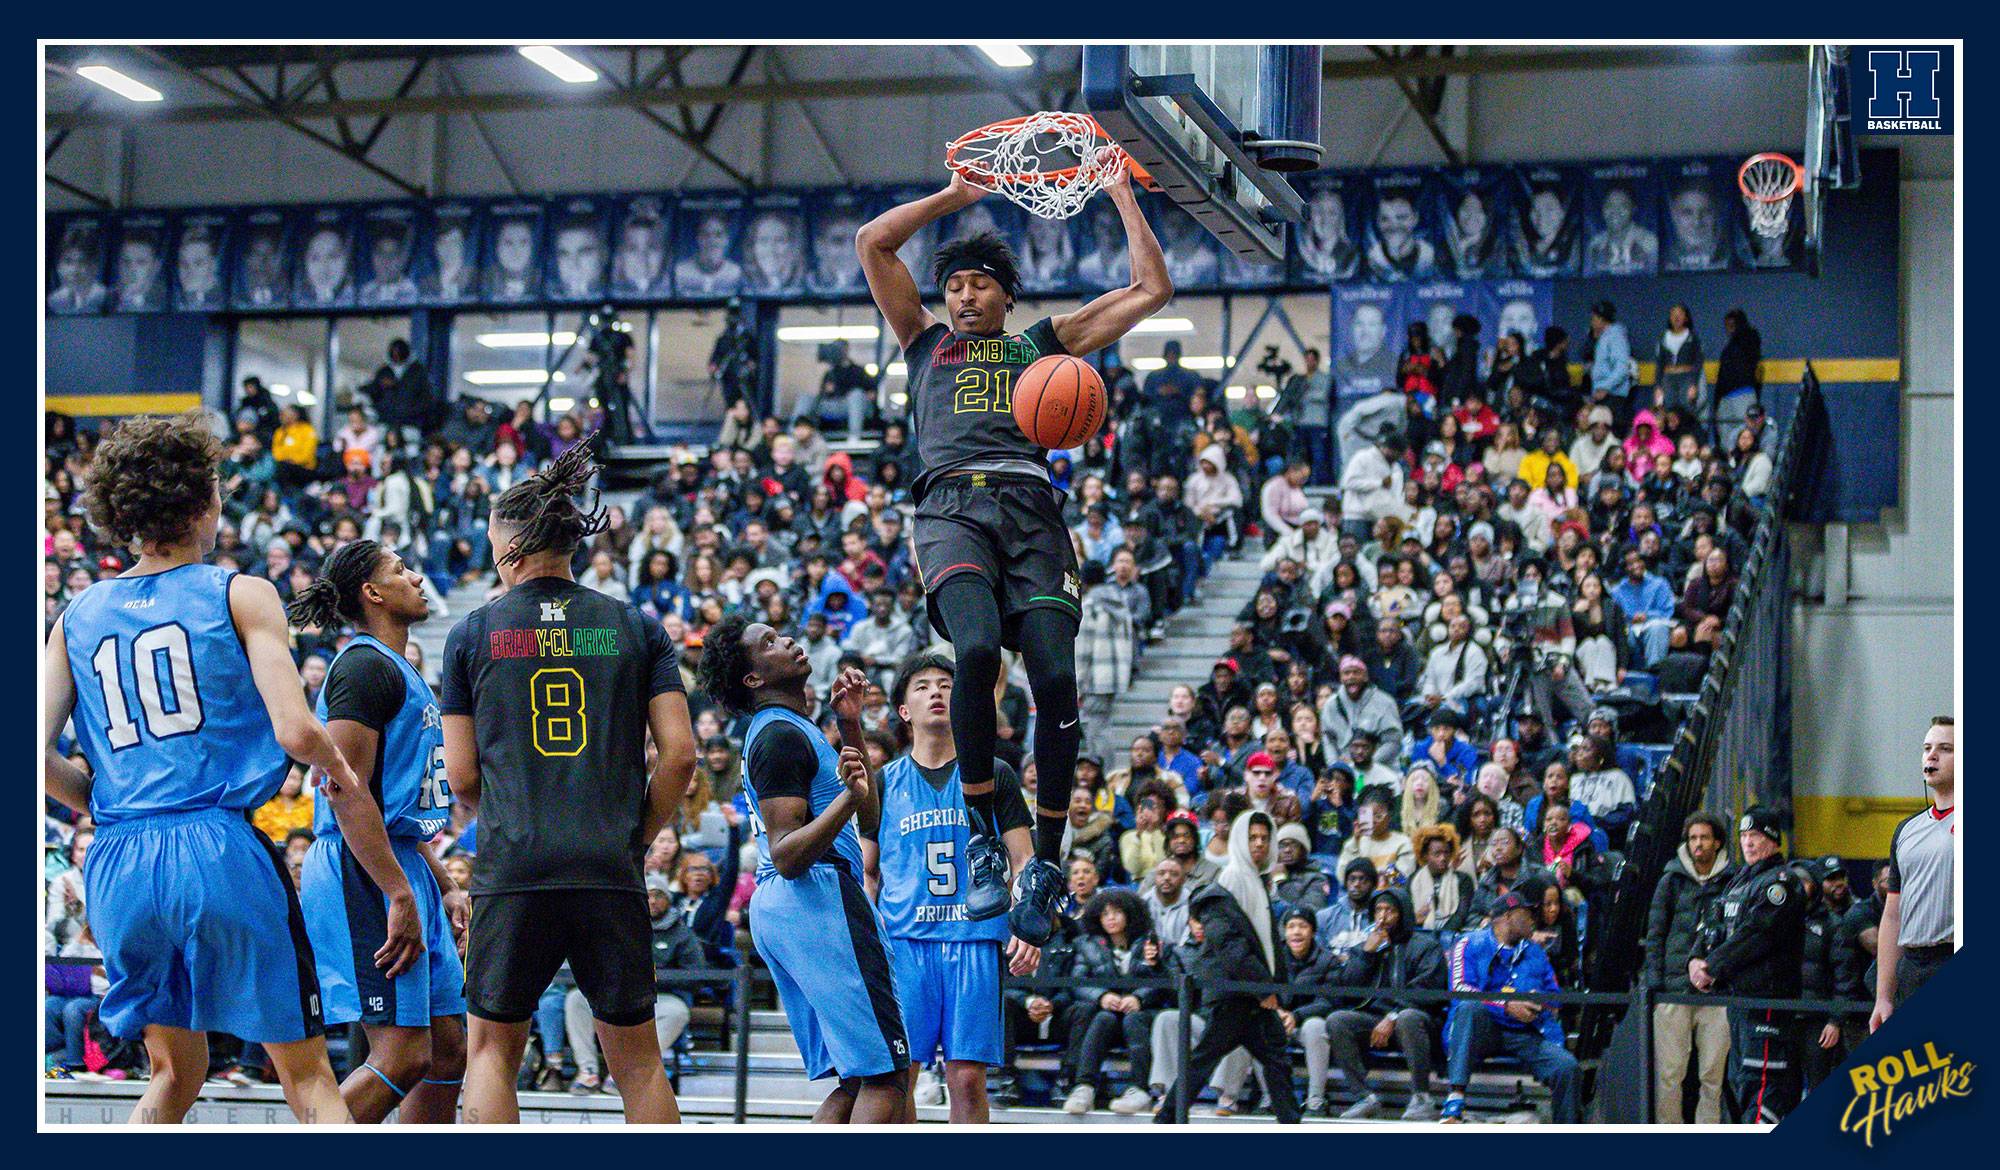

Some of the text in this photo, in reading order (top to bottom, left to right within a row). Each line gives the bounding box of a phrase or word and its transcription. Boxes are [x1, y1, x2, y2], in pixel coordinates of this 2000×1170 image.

[932, 339, 1037, 367] HUMBER
[954, 367, 1011, 414] 21
[90, 620, 206, 754] 10
[530, 667, 587, 757] 8
[900, 808, 969, 836] SHERIDA
[926, 840, 957, 896] 5
[310, 993, 320, 1017] 10
[368, 996, 384, 1012] 42
[893, 1039, 906, 1055] 25
